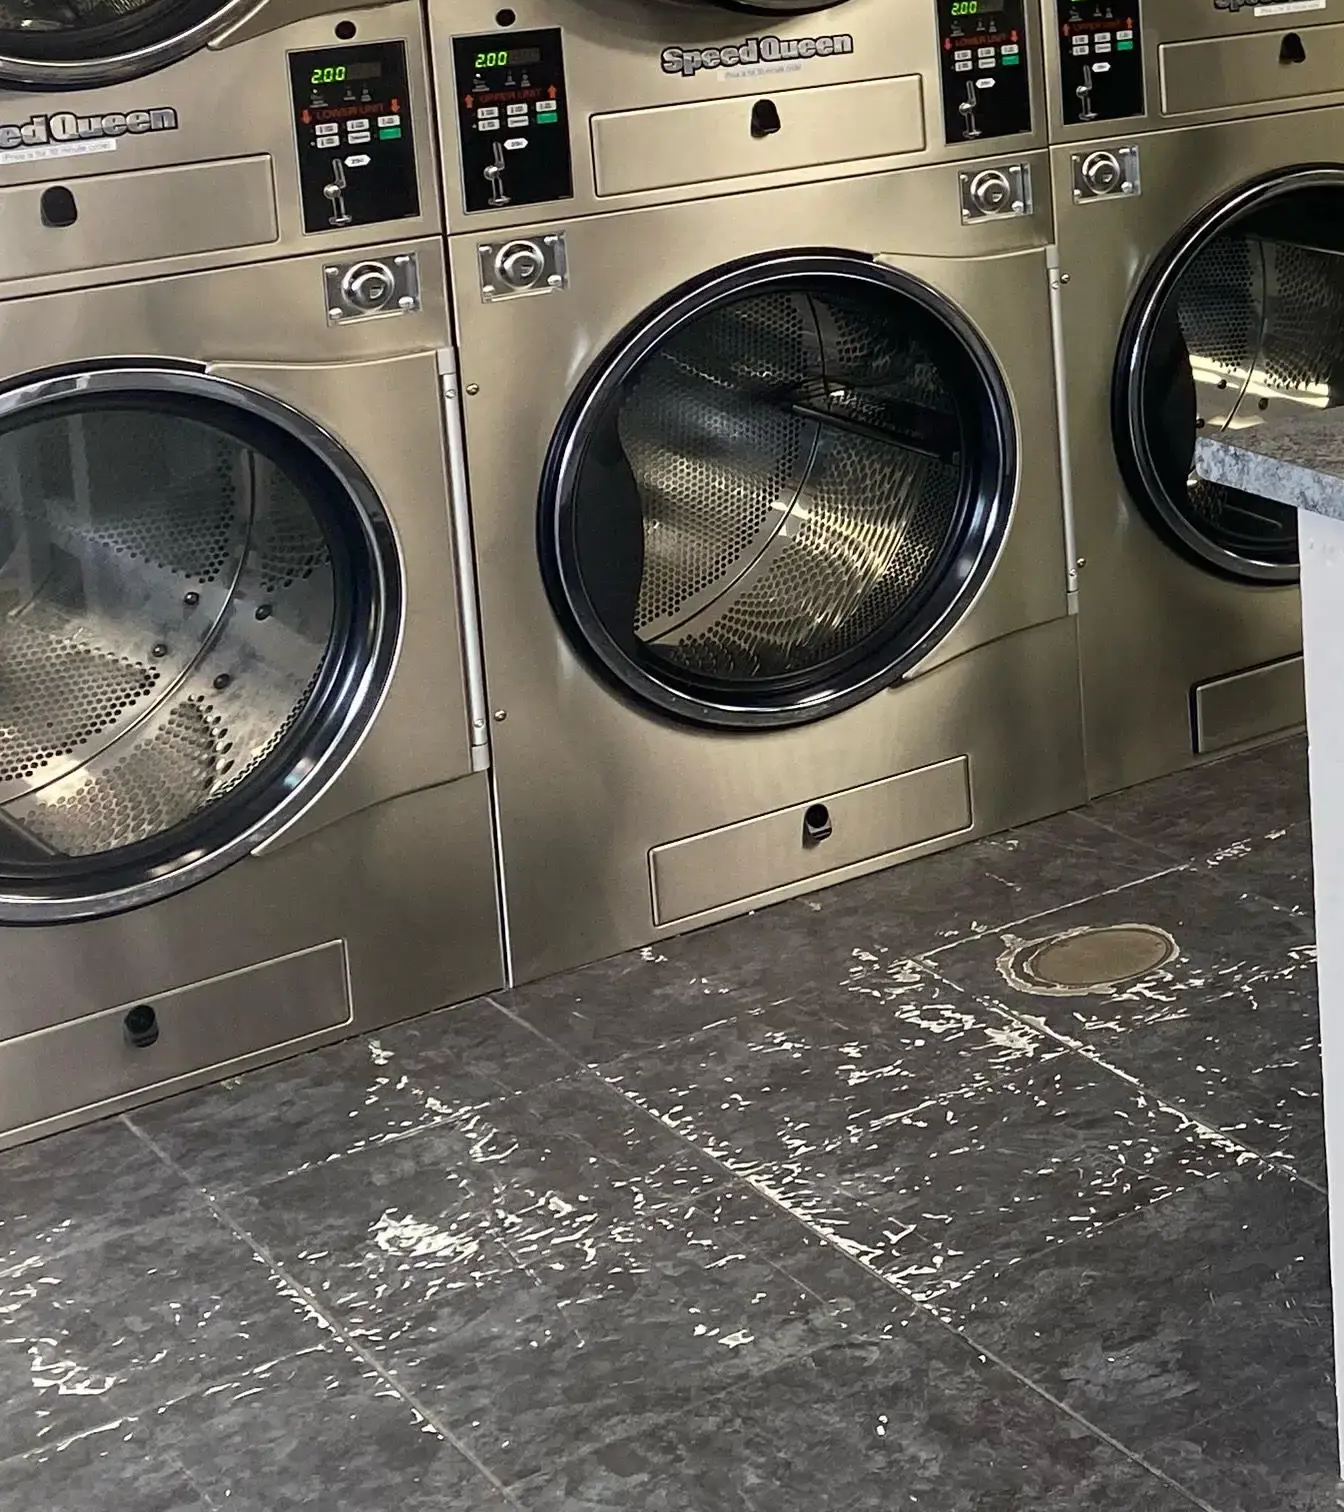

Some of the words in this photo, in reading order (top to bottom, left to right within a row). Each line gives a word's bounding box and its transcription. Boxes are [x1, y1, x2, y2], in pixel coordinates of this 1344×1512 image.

[661, 37, 759, 77] Speed
[759, 34, 853, 61] Queen
[50, 106, 178, 142] Queen
